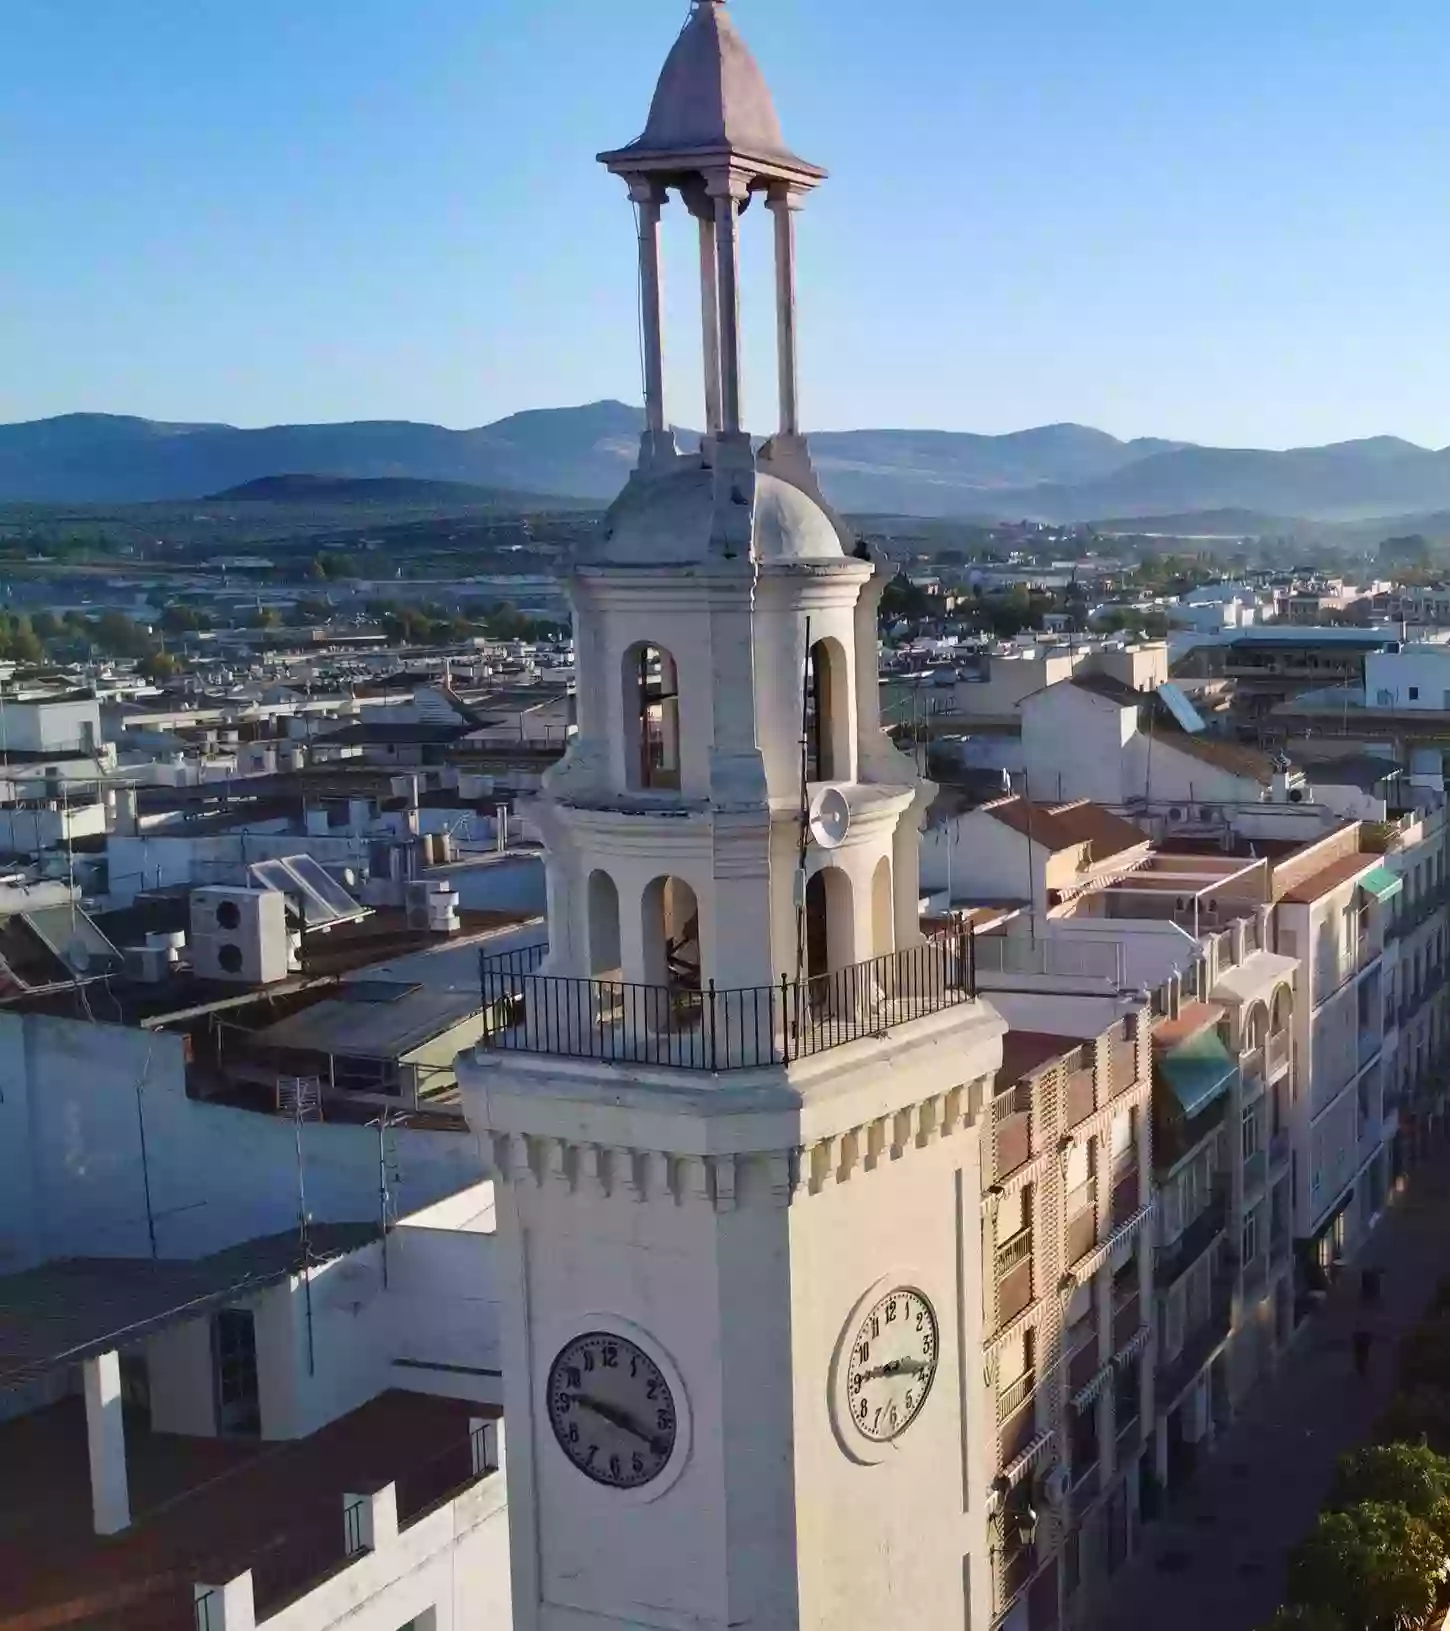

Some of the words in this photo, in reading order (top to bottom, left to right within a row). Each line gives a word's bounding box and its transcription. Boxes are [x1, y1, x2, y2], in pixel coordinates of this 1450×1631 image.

[885, 1301, 896, 1325] 12
[904, 1301, 910, 1320] 1
[871, 1316, 880, 1340] 11
[915, 1312, 923, 1332] 2
[858, 1341, 869, 1367] 10
[923, 1334, 930, 1354] 3
[583, 1350, 594, 1372] 11
[601, 1347, 618, 1367] 12
[629, 1356, 637, 1377] 1
[854, 1373, 862, 1394] 9
[918, 1367, 925, 1382] 4
[647, 1379, 658, 1400] 2
[905, 1389, 913, 1409] 5
[559, 1392, 571, 1413] 9
[860, 1398, 868, 1418] 8
[657, 1409, 669, 1430] 3
[874, 1407, 882, 1428] 7
[889, 1406, 897, 1430] 6
[568, 1422, 579, 1442] 8
[586, 1445, 599, 1466] 7
[609, 1454, 621, 1476] 6
[632, 1452, 643, 1472] 5
